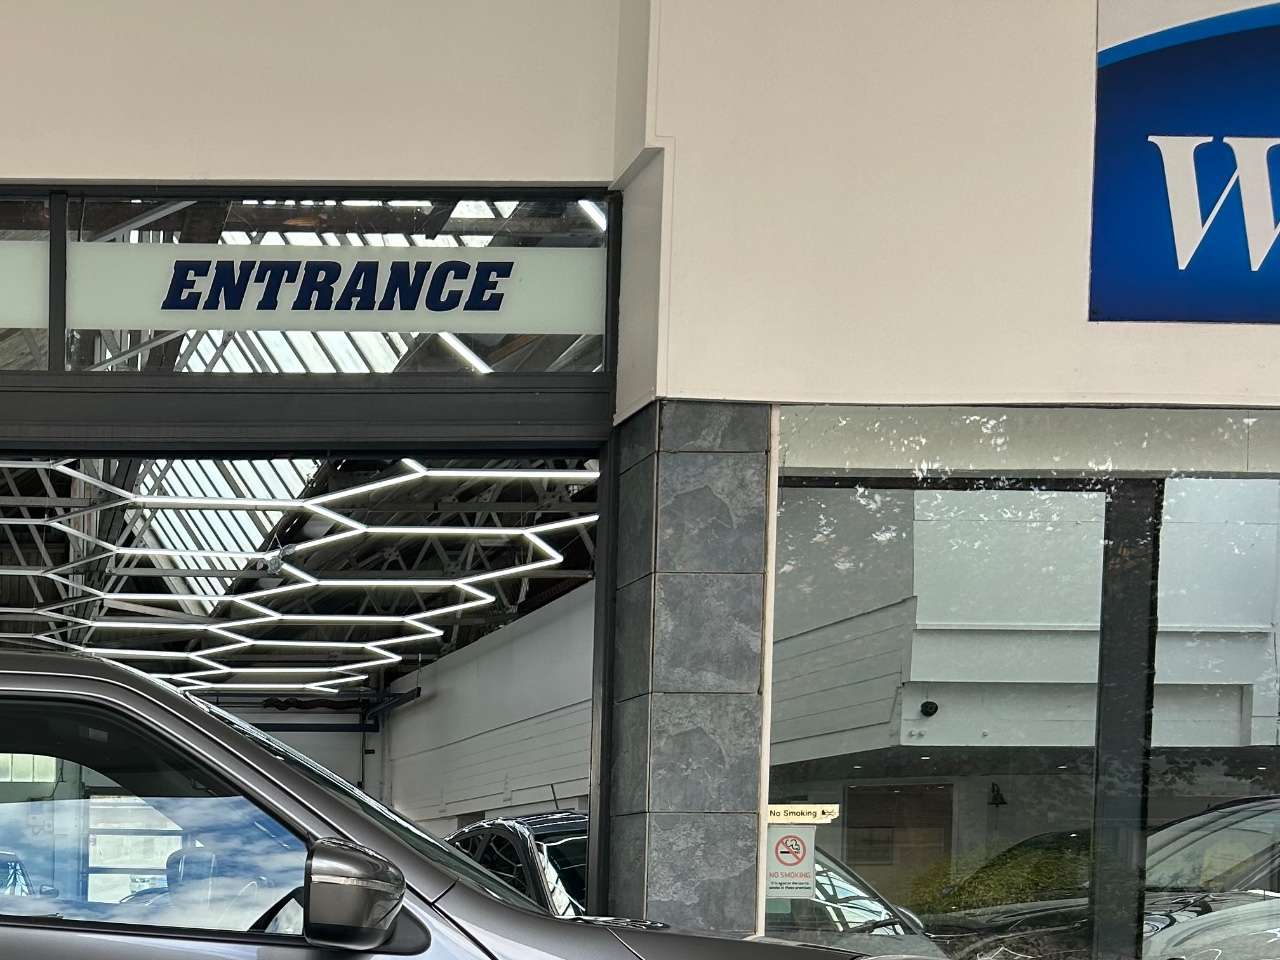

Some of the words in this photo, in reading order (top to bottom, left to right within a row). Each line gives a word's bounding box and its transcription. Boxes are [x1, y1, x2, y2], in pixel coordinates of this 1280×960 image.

[1147, 136, 1280, 271] W
[161, 260, 514, 311] ENTRANCE
[783, 810, 817, 819] Smoking
